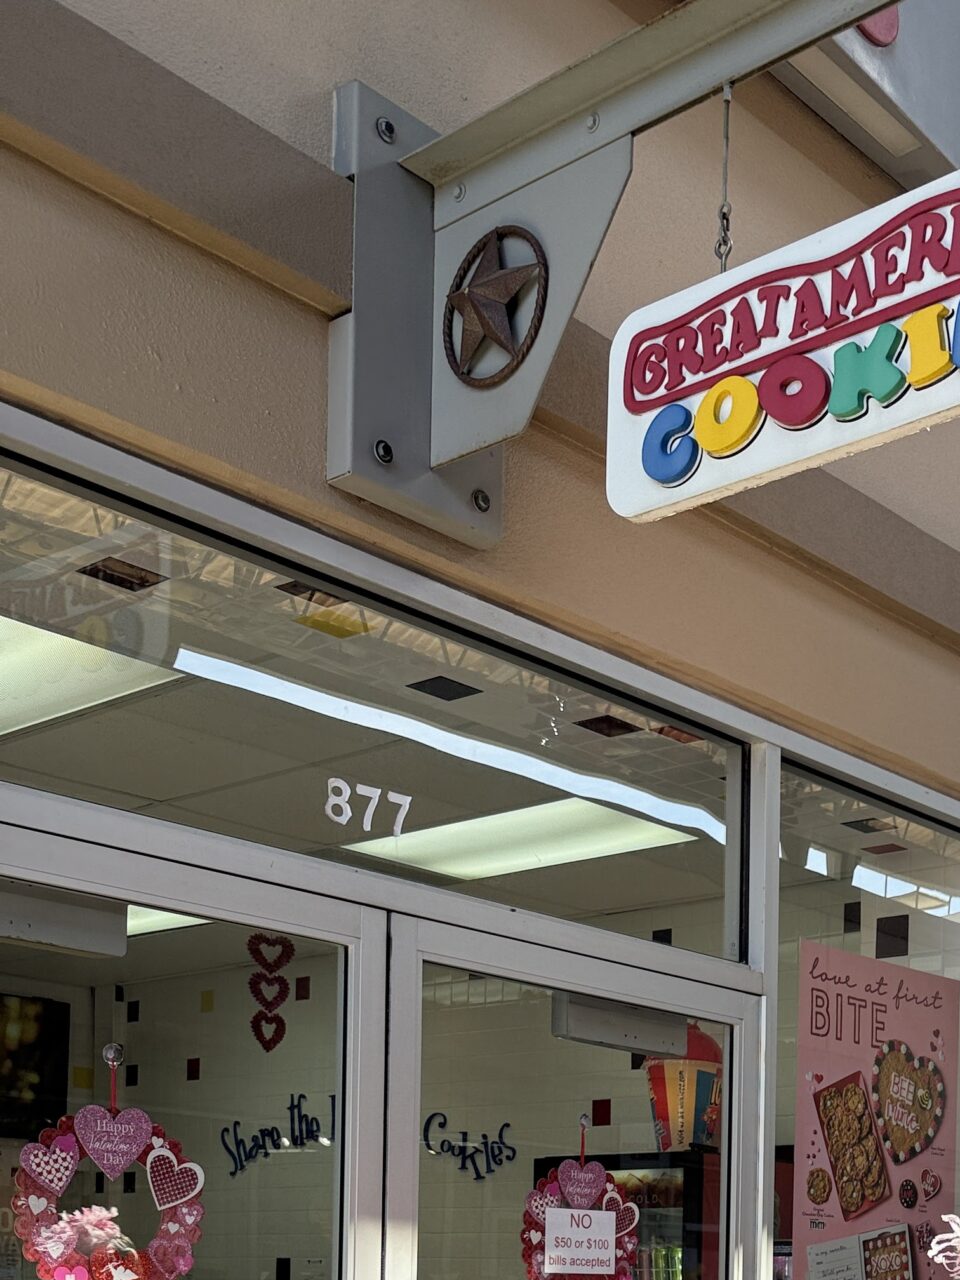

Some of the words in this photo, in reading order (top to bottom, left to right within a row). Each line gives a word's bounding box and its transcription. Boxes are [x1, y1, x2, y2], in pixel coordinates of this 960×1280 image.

[632, 284, 792, 396] GREAT
[325, 777, 412, 837] 877
[809, 957, 857, 988] love
[864, 976, 889, 996] at
[892, 979, 943, 1010] first
[810, 987, 888, 1049] BITE
[97, 1119, 136, 1136] Happy
[287, 1093, 320, 1146] the
[103, 1152, 126, 1166] Day
[571, 1170, 595, 1182] Happy
[574, 1194, 588, 1206] Day
[570, 1213, 592, 1229] NO
[554, 1236, 572, 1249] $50
[575, 1239, 584, 1249] or
[586, 1238, 609, 1250] $100
[549, 1253, 567, 1266] bills
[569, 1256, 611, 1269] accepted
